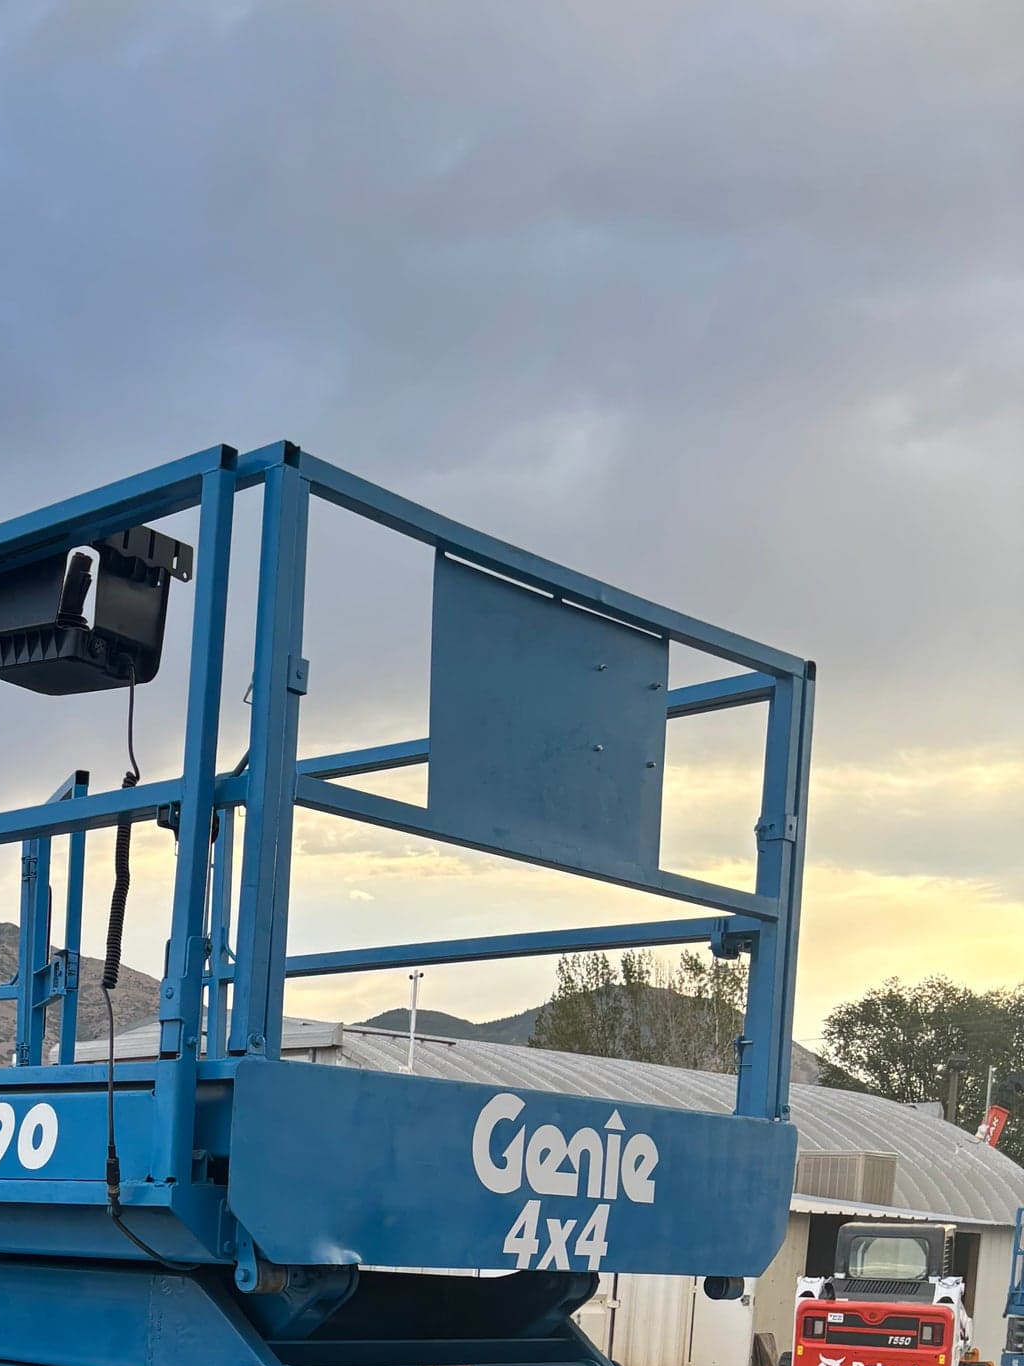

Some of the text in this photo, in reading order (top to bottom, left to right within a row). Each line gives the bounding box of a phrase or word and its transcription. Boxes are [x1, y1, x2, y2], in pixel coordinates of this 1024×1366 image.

[472, 1092, 659, 1204] Genie
[503, 1200, 610, 1271] 4x4
[888, 1336, 912, 1346] T550
